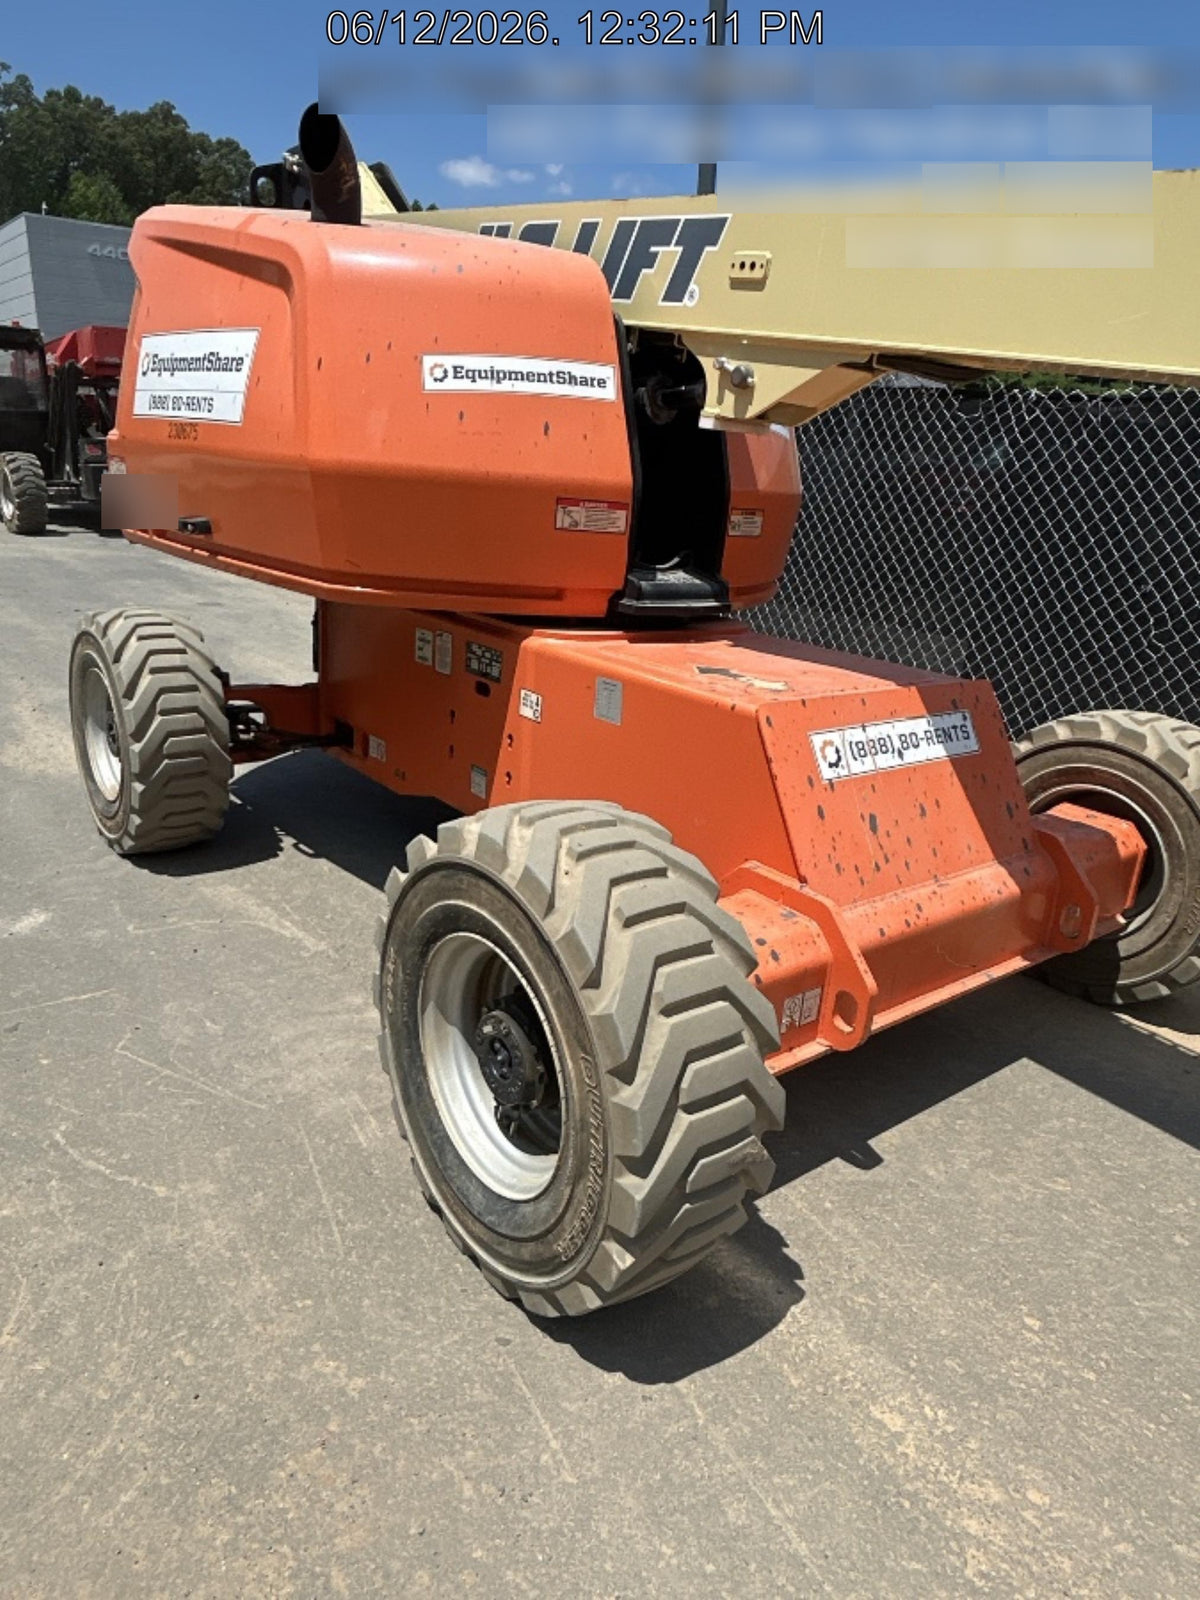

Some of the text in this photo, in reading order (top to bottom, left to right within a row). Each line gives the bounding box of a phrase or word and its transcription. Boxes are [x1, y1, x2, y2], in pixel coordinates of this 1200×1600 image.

[151, 352, 244, 377] EquipmentShare
[452, 365, 607, 389] EquipmentShare
[849, 724, 970, 761] (888) 80-RENTS
